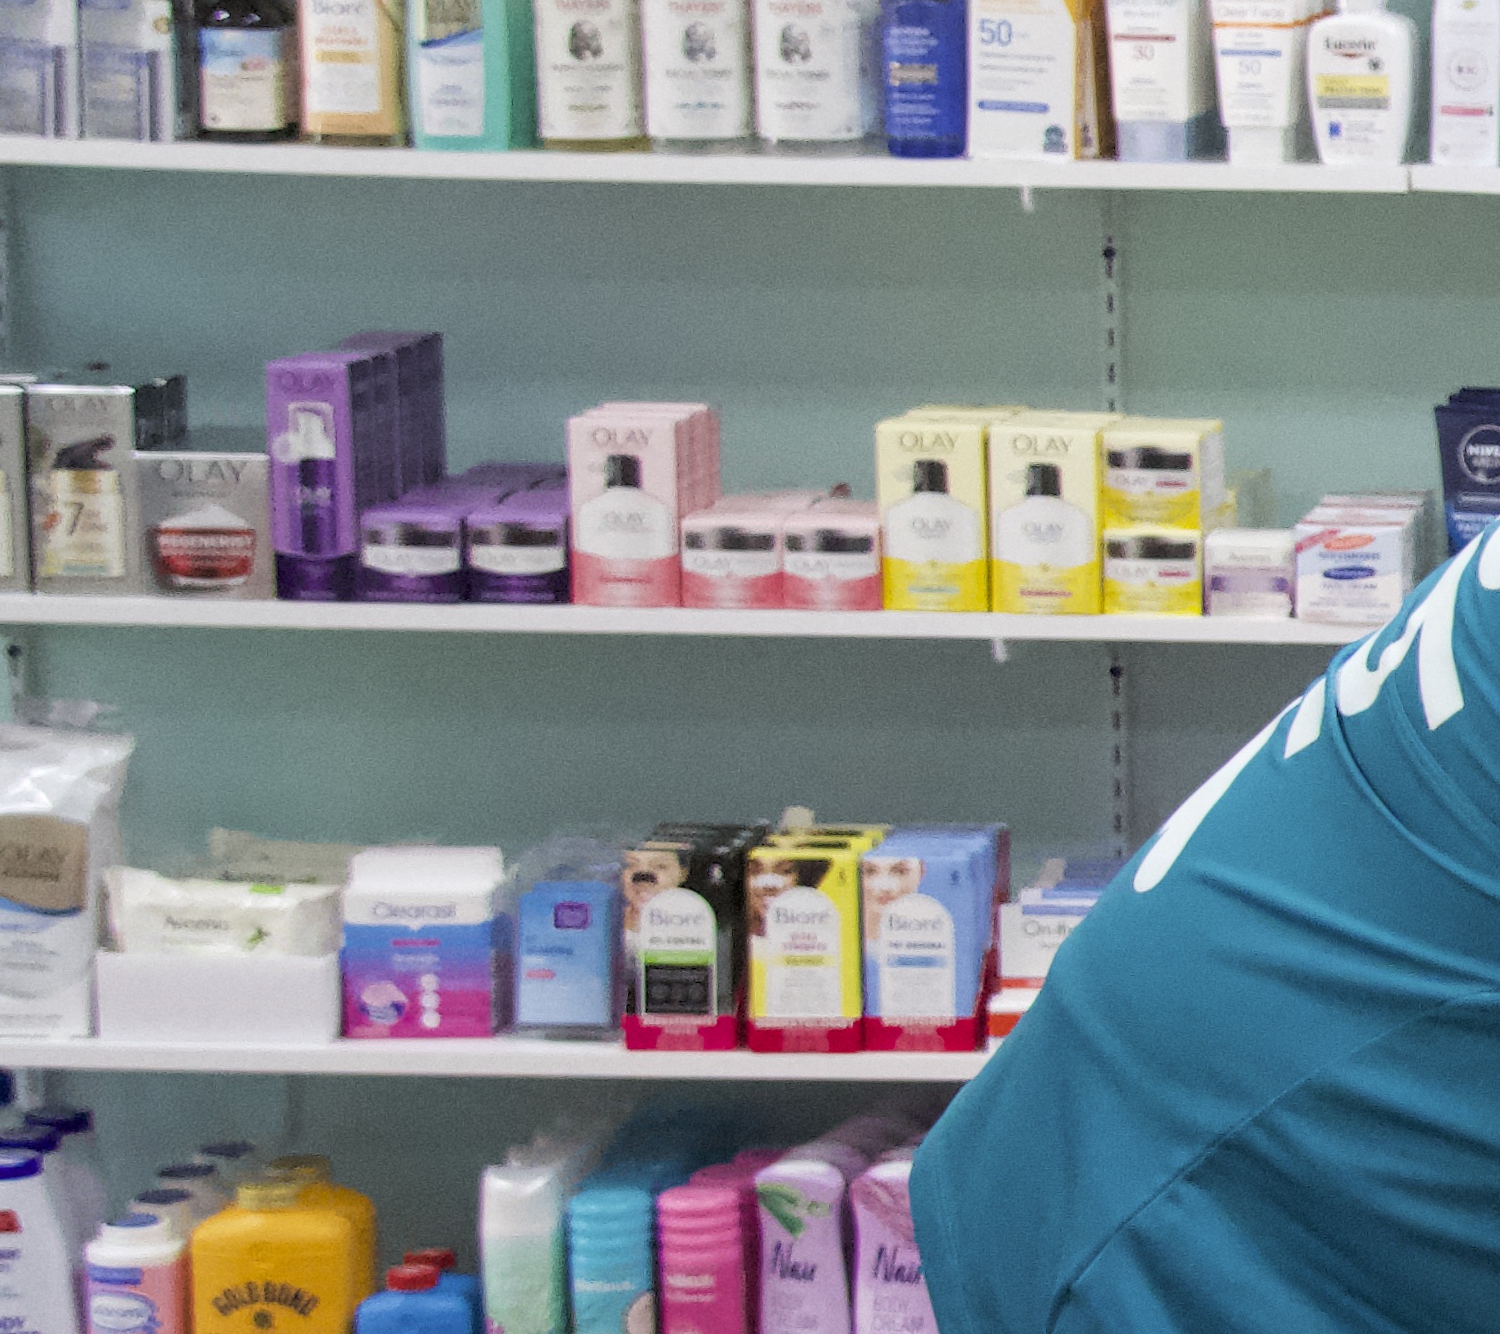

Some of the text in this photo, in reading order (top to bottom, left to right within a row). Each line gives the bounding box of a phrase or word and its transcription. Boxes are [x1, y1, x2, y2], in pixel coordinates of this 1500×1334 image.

[899, 432, 958, 454] OLAY
[1011, 435, 1074, 456] OLAY
[157, 459, 248, 484] OLAY
